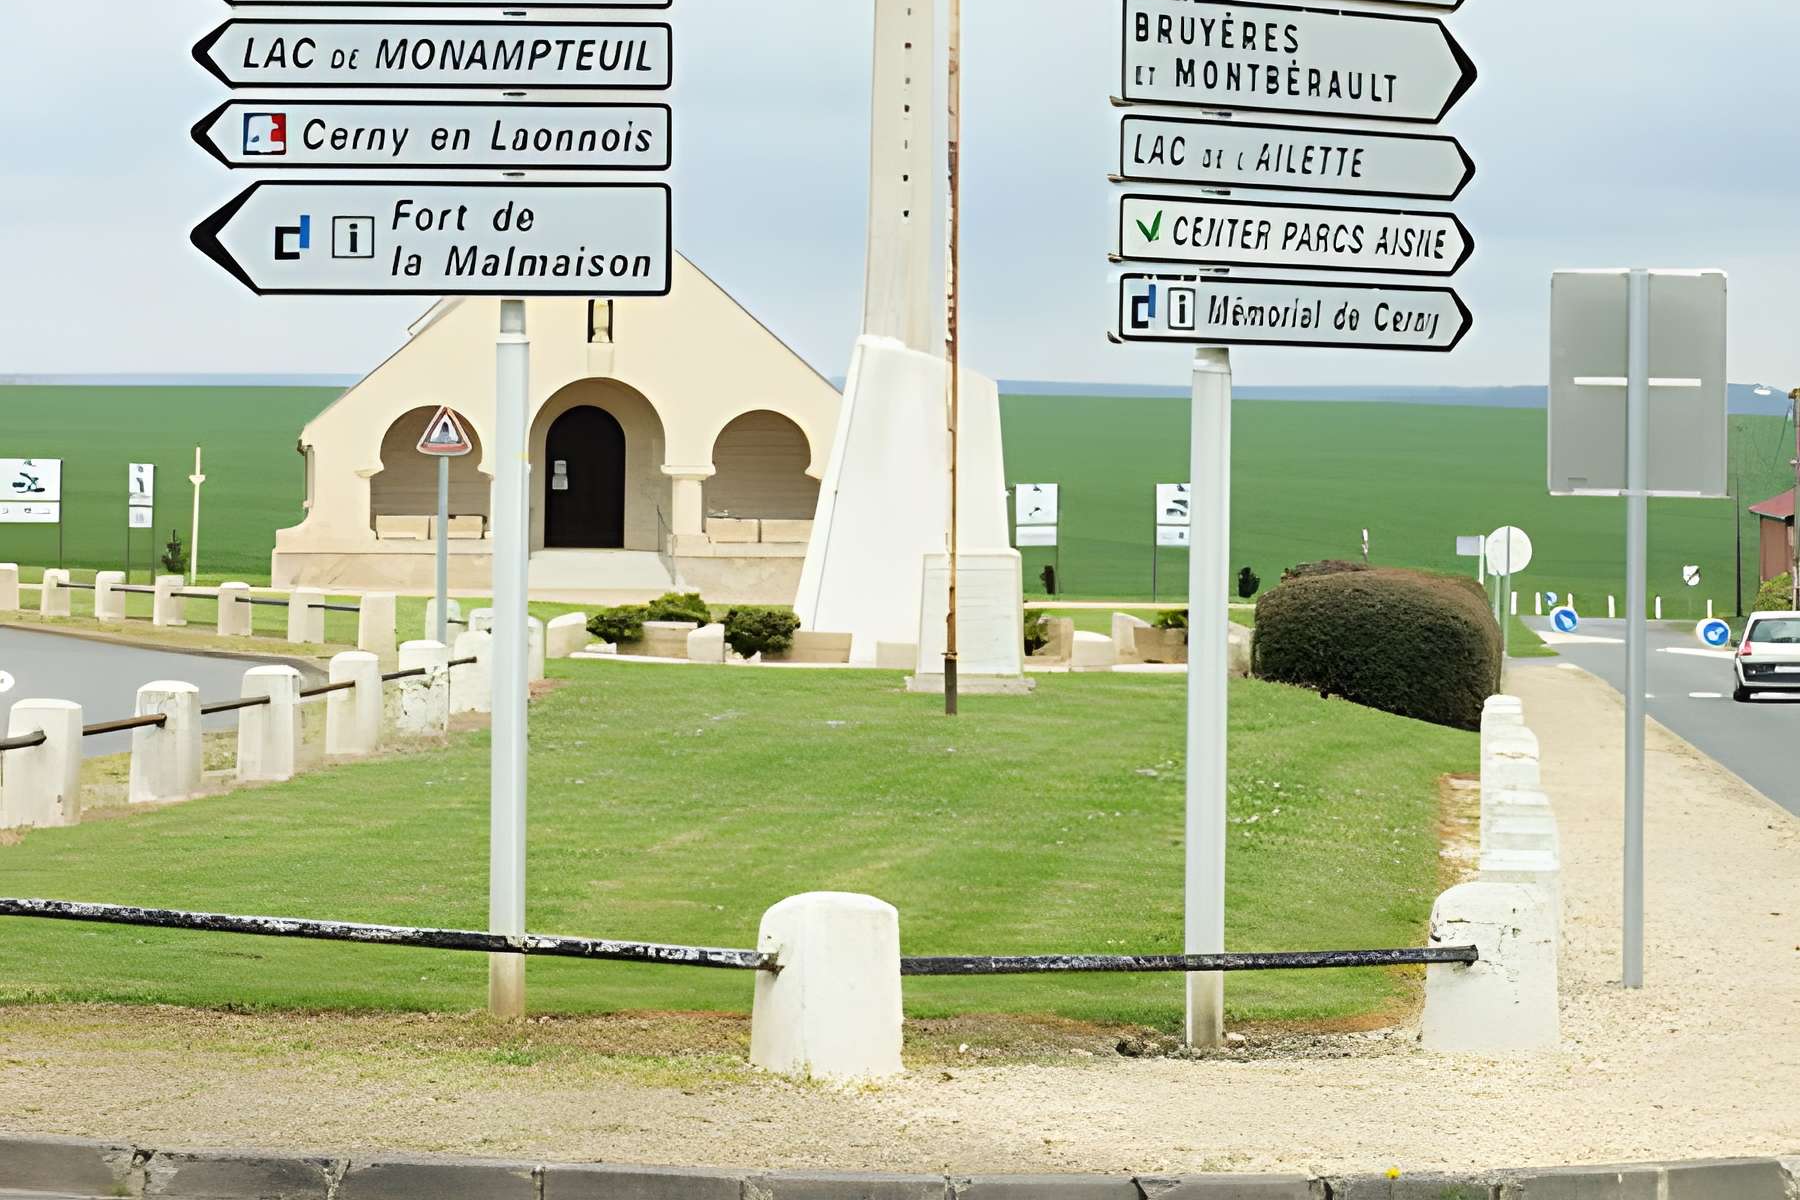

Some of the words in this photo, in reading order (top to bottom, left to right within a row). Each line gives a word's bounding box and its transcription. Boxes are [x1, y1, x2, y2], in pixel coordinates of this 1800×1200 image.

[243, 37, 316, 69] LAC
[330, 48, 360, 70] DE
[375, 38, 652, 72] MONAMPTEUIL
[303, 118, 410, 157] Cerny
[430, 127, 471, 151] en
[490, 119, 653, 153] Laonnois
[1133, 133, 1186, 166] LAC
[391, 199, 468, 232] Fort
[492, 200, 535, 232] de
[1281, 221, 1365, 255] PARCS
[391, 244, 422, 277] la
[444, 245, 651, 278] Malmaison
[1333, 300, 1361, 331] de
